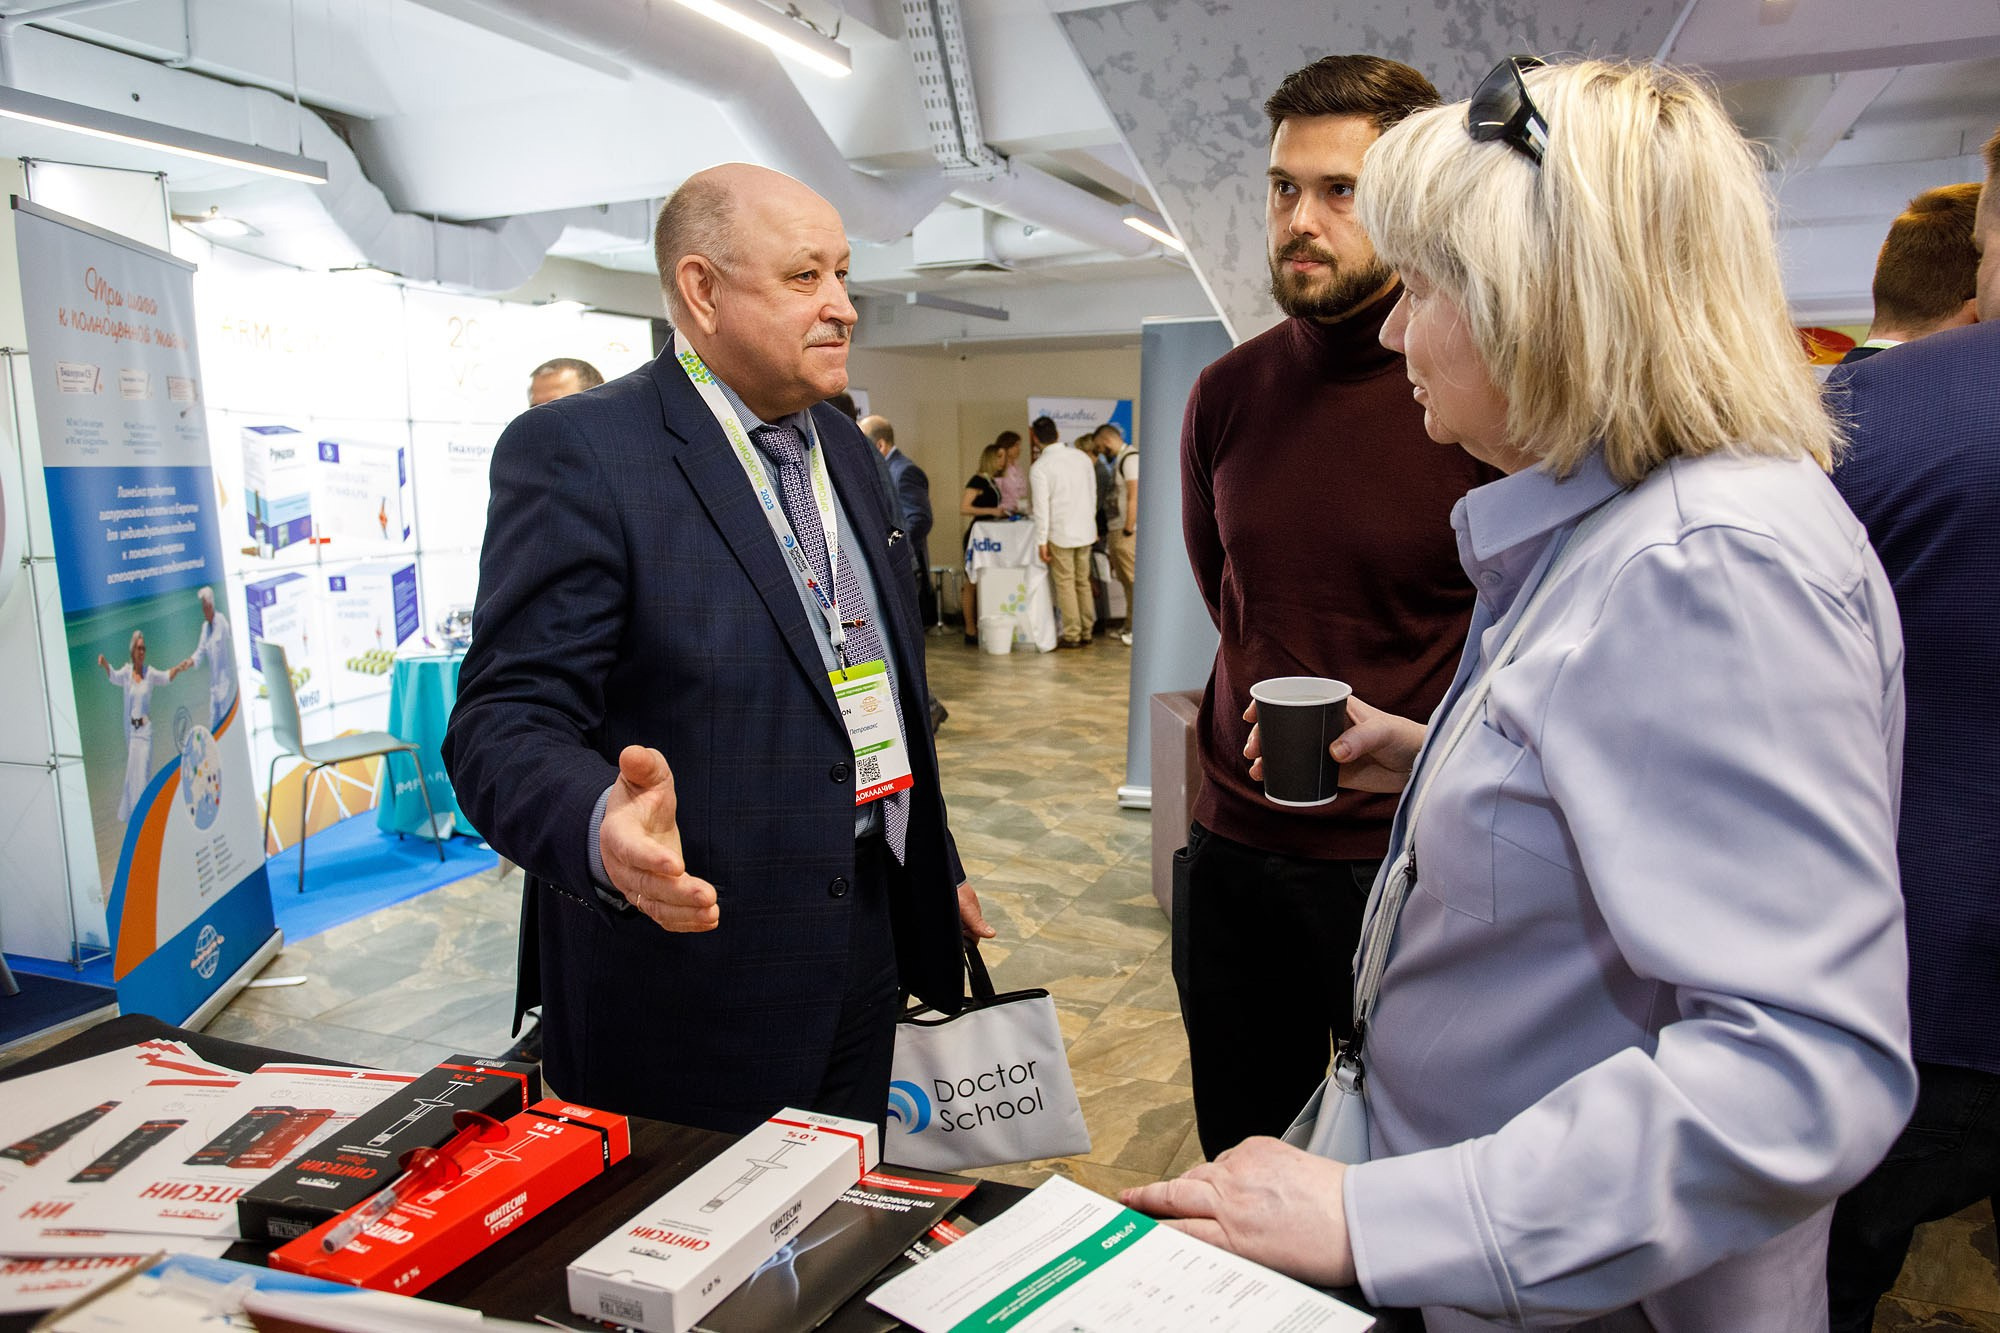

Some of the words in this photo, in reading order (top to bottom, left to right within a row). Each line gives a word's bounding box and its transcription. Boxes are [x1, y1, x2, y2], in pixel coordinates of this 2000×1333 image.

[724, 417, 768, 488] ОРТОБИОЛОГИЯ
[760, 488, 774, 511] 2023
[788, 549, 806, 574] School
[793, 546, 808, 572] Doctor
[856, 783, 894, 803] ДОКЛАДЧИК
[934, 1060, 1037, 1103] Doctor
[940, 1086, 1043, 1132] School
[139, 1182, 245, 1204] ТЕСИН
[879, 1193, 914, 1206] ЛЮБОЙ
[914, 1199, 936, 1208] ПРИ
[19, 1201, 75, 1220] ИН
[484, 1191, 527, 1227] СИНТЕСИН
[770, 1200, 802, 1234] СИНТЕСИН
[363, 1222, 414, 1244] СИНТЕ
[628, 1226, 711, 1252] СИНТЕСИН
[3, 1256, 141, 1275] ИНТЕСИН
